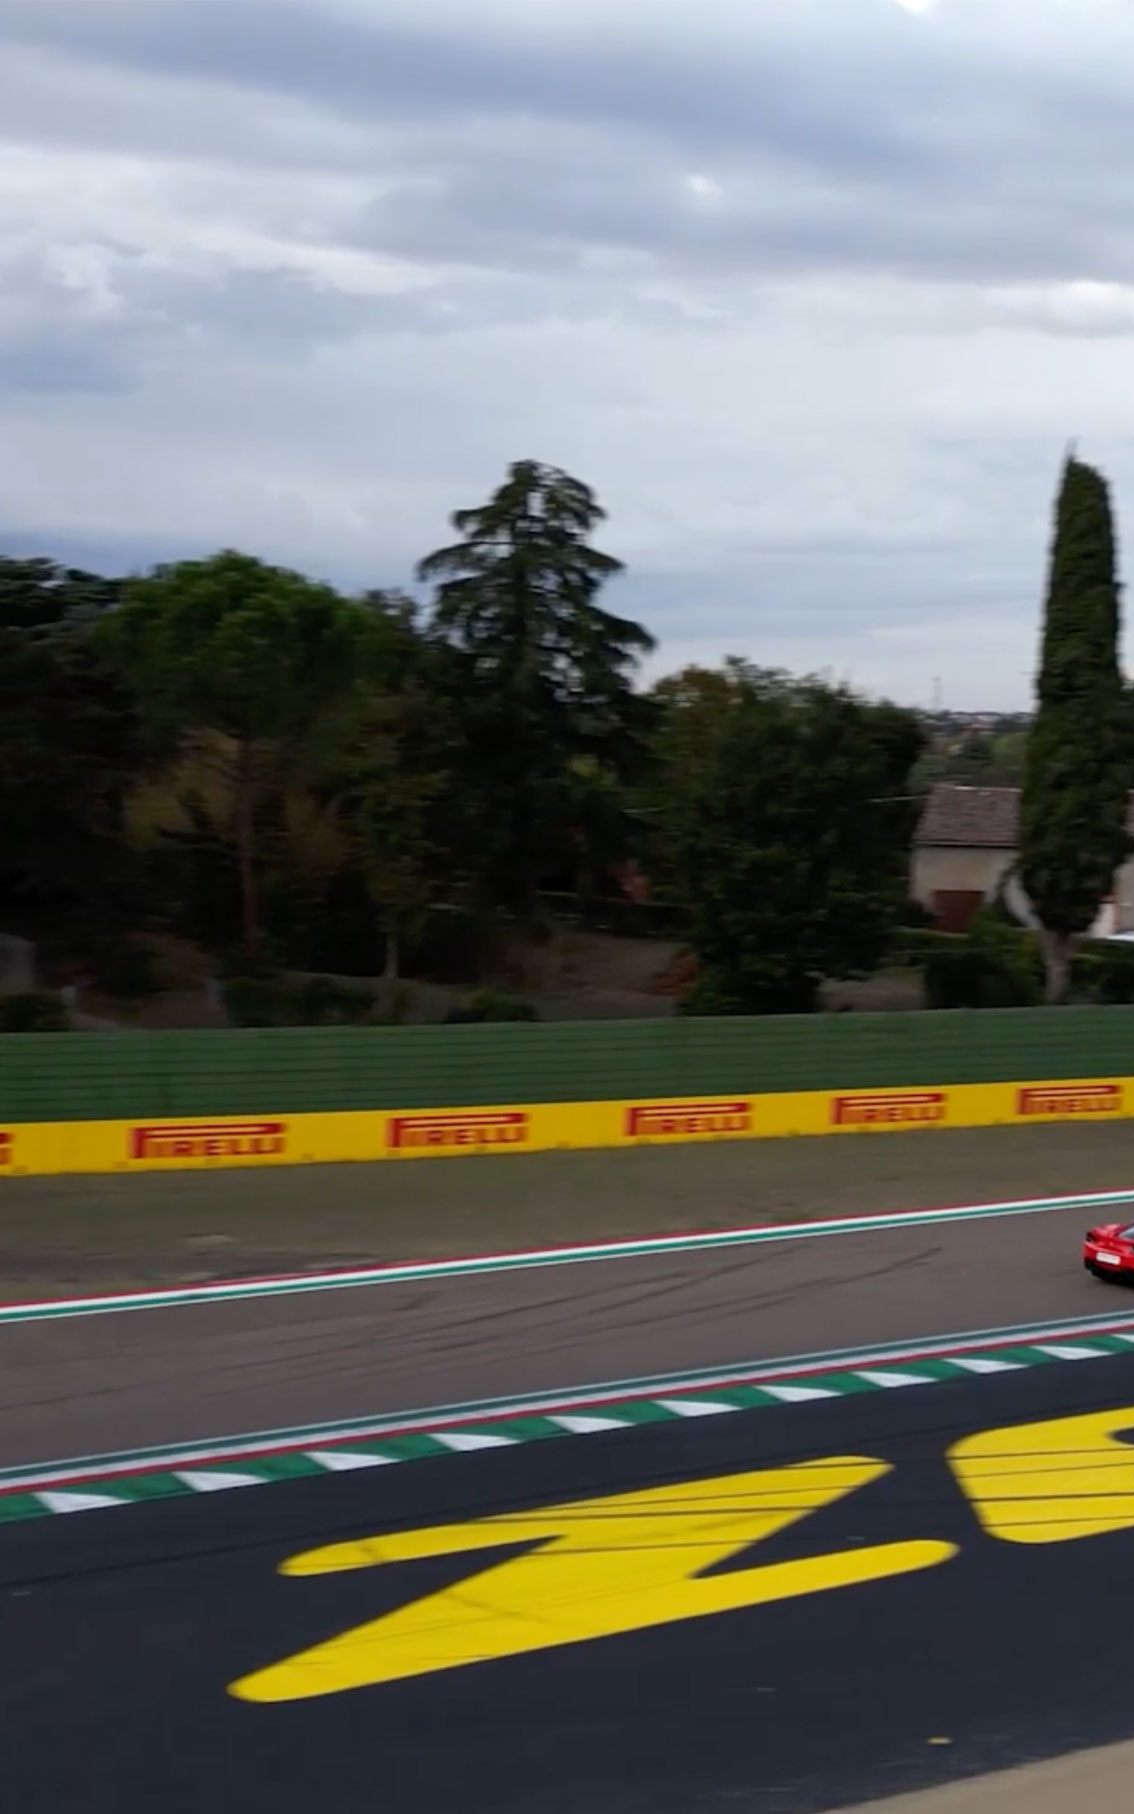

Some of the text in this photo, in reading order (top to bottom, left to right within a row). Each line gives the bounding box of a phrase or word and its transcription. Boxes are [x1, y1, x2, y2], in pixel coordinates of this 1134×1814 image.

[830, 1092, 945, 1125] PIRELLI
[1016, 1083, 1121, 1116] PIRELLI
[385, 1112, 529, 1149] PIRELLI
[624, 1101, 752, 1137] PIRELLI
[129, 1122, 286, 1159] PIRELLI
